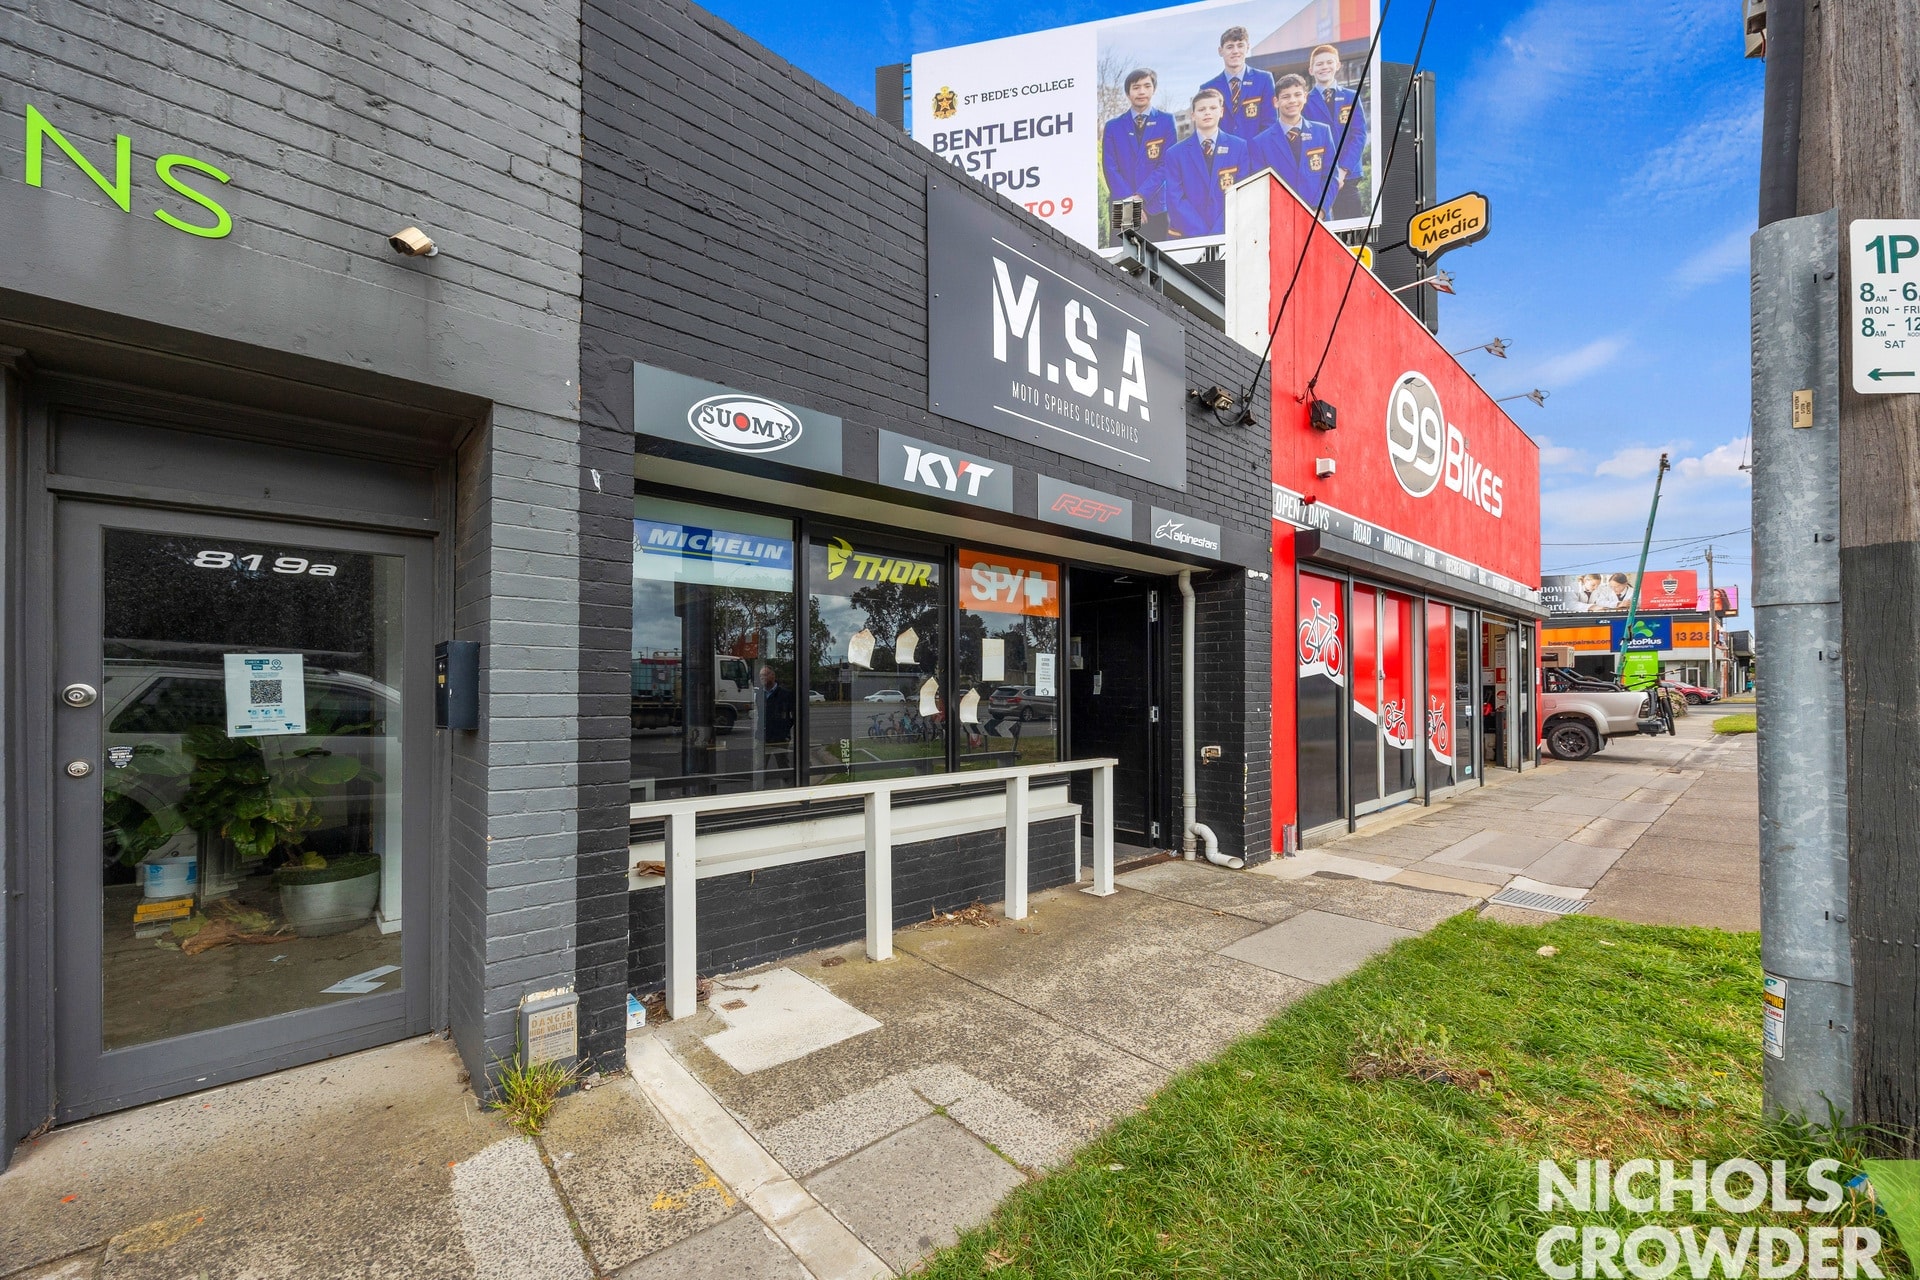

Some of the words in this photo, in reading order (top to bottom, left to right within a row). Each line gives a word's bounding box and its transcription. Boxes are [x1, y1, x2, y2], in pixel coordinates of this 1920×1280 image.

[964, 94, 978, 105] ST
[981, 88, 1018, 102] BEDE'S
[1021, 78, 1075, 96] COLLEGE
[933, 112, 1073, 153] BENTLEIGH
[26, 104, 233, 239] NS
[945, 148, 997, 172] AST
[1025, 200, 1055, 218] TO
[1061, 197, 1073, 215] 9
[1418, 208, 1462, 231] Civic
[1422, 217, 1479, 246] Media
[1865, 234, 1920, 274] 1P
[1902, 281, 1920, 301] 6
[1865, 306, 1889, 315] MON
[1884, 340, 1906, 349] SAT
[1012, 381, 1039, 406] MOTO
[1045, 393, 1080, 421] SPARES
[1085, 408, 1138, 443] ACCESSORIES
[1389, 387, 1441, 477] 99
[902, 445, 994, 497] KYT
[1051, 493, 1122, 523] RST
[1173, 529, 1218, 551] alpinestars
[1275, 492, 1300, 521] OPEN
[1308, 503, 1330, 531] DAYS
[1353, 521, 1372, 546] ROAD
[1383, 533, 1414, 561] MOUNTAIN
[647, 528, 784, 560] MICHELIN
[193, 550, 338, 577] 819a
[852, 554, 933, 588] THOR
[1540, 594, 1562, 602] een.
[1541, 584, 1575, 593] nown.
[1675, 632, 1687, 641] 13
[1690, 631, 1704, 641] 23
[531, 1010, 573, 1029] DANGER
[547, 1019, 575, 1033] VOLTAGE
